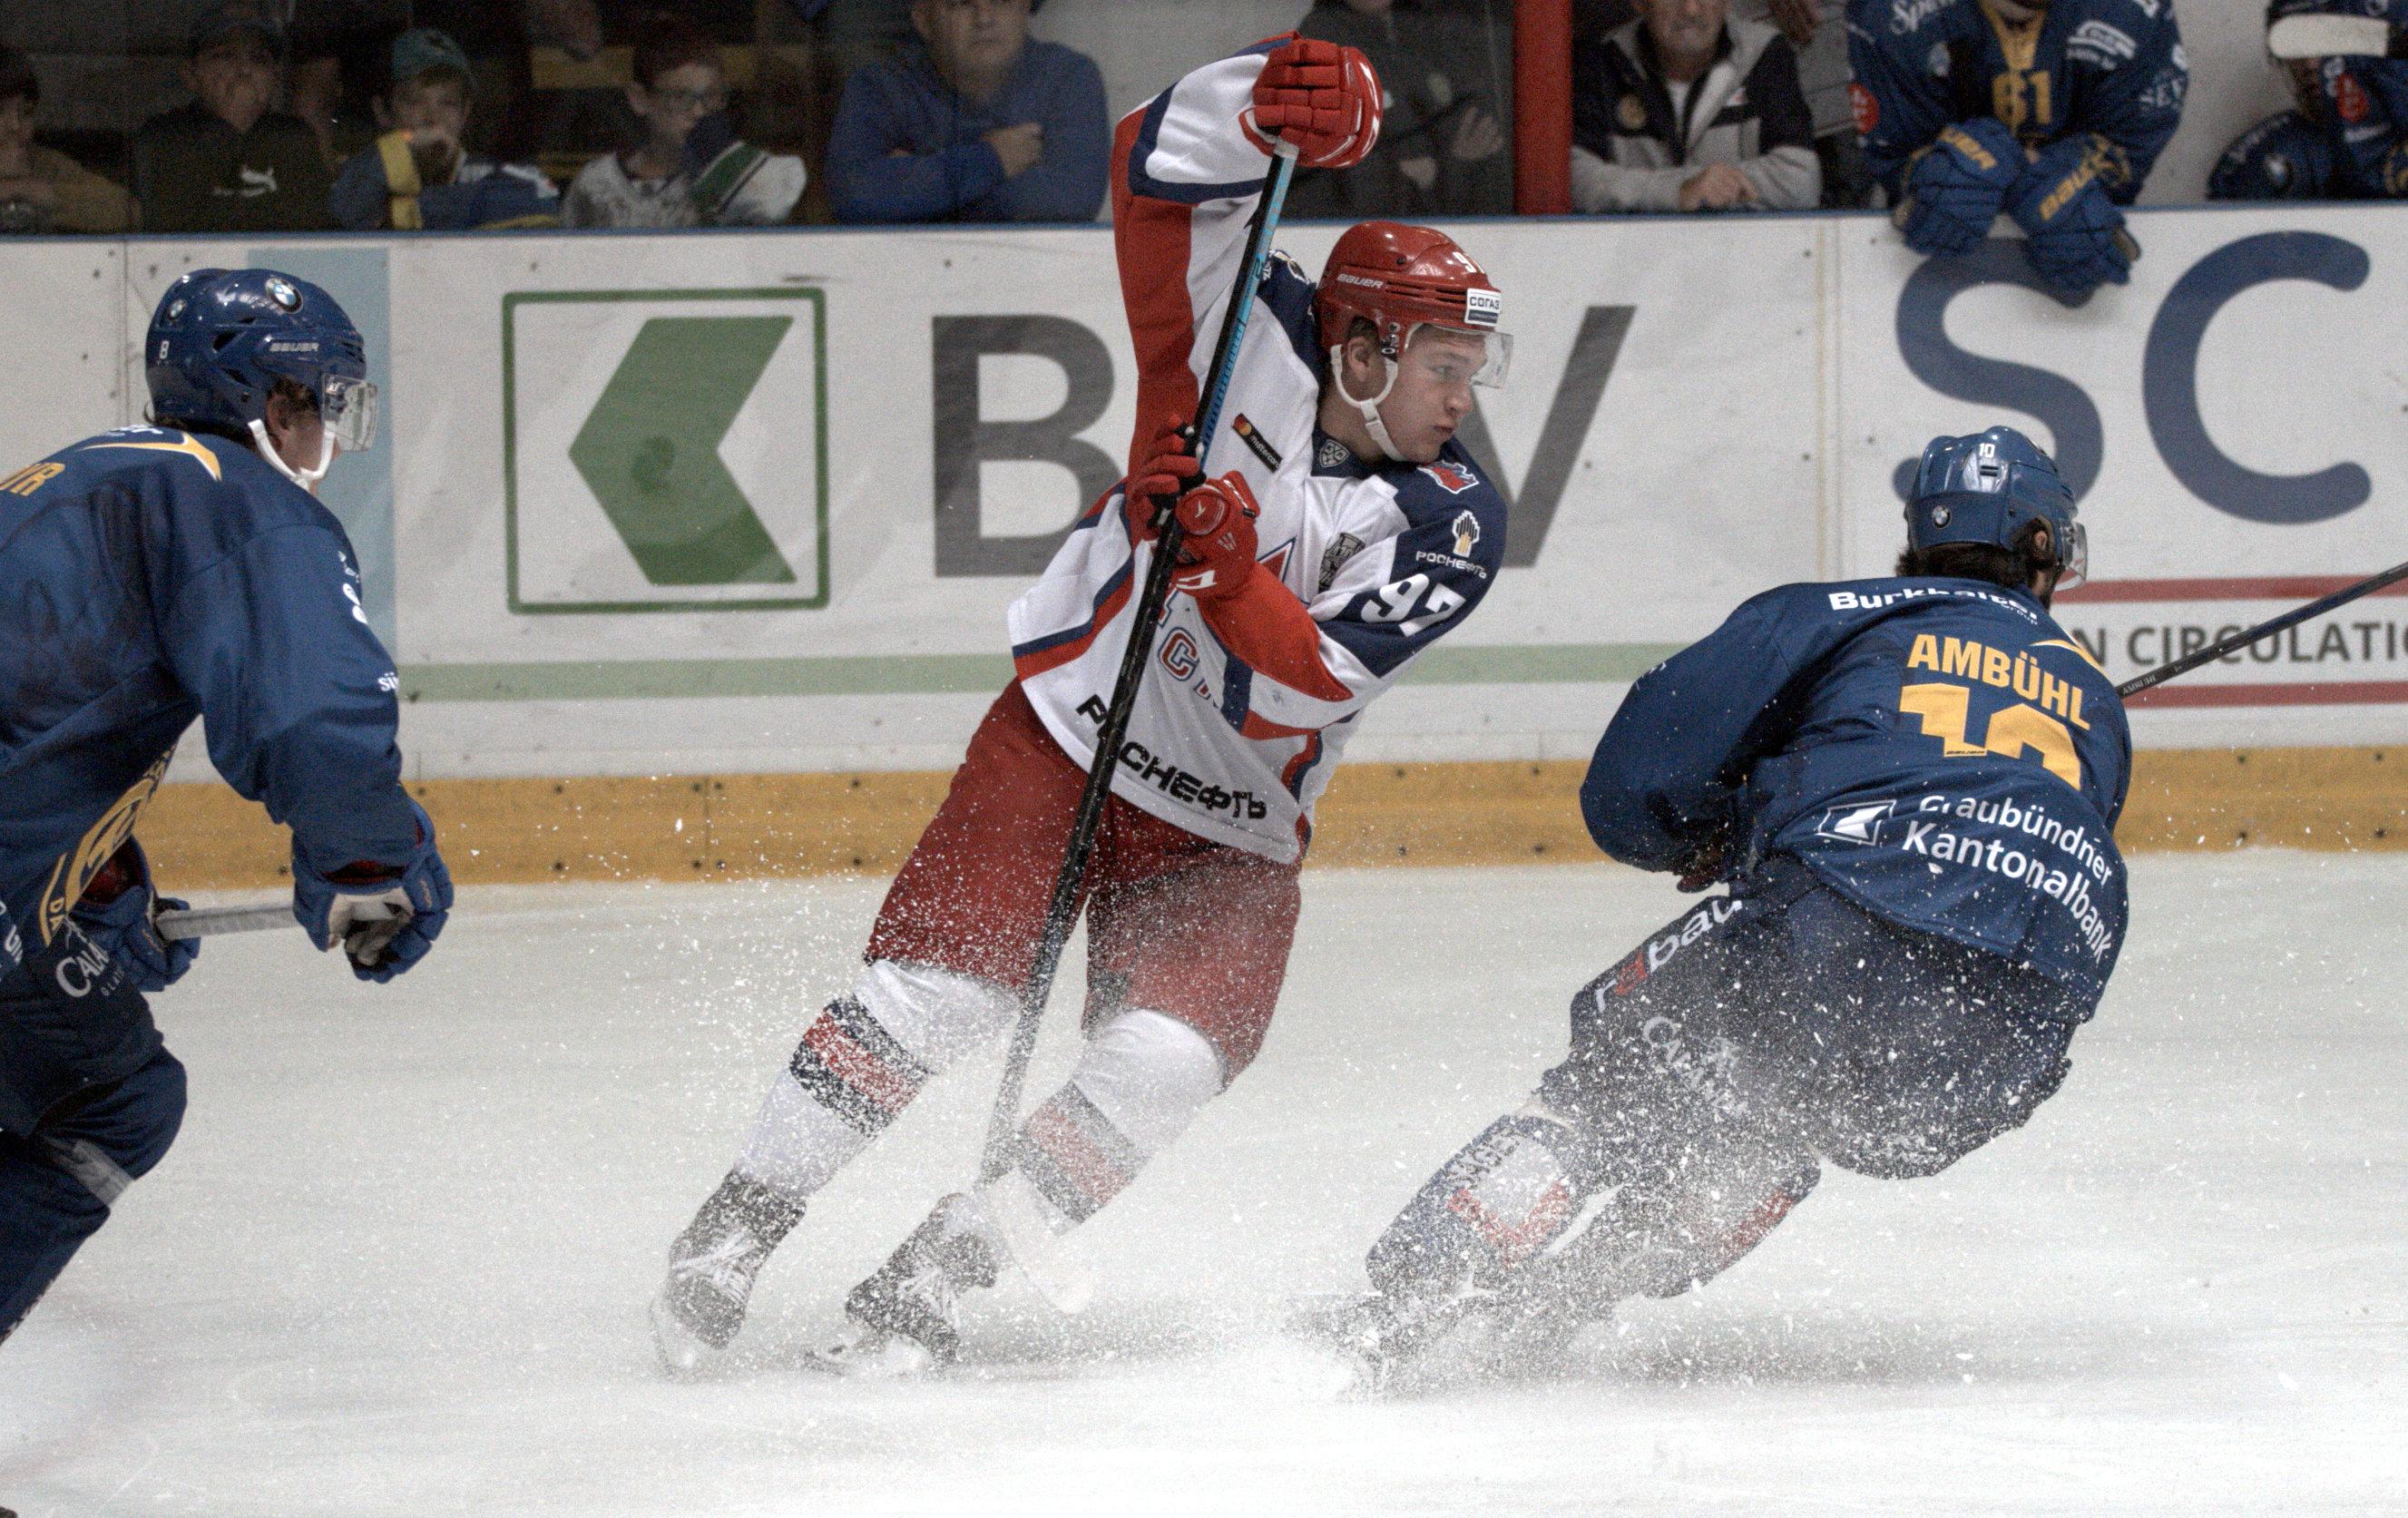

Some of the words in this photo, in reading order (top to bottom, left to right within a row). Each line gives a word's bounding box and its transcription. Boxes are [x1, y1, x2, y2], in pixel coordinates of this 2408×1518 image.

[1336, 274, 1384, 289] BAUER
[159, 340, 170, 359] 8
[1979, 443, 1996, 458] 10
[1361, 573, 1467, 637] 97
[2127, 622, 2408, 666] CIRCULATI
[1907, 633, 2090, 730] AMBÜHL
[1076, 694, 1267, 819] РСНЕФТЬ
[1903, 820, 2111, 965] Kantonalbank
